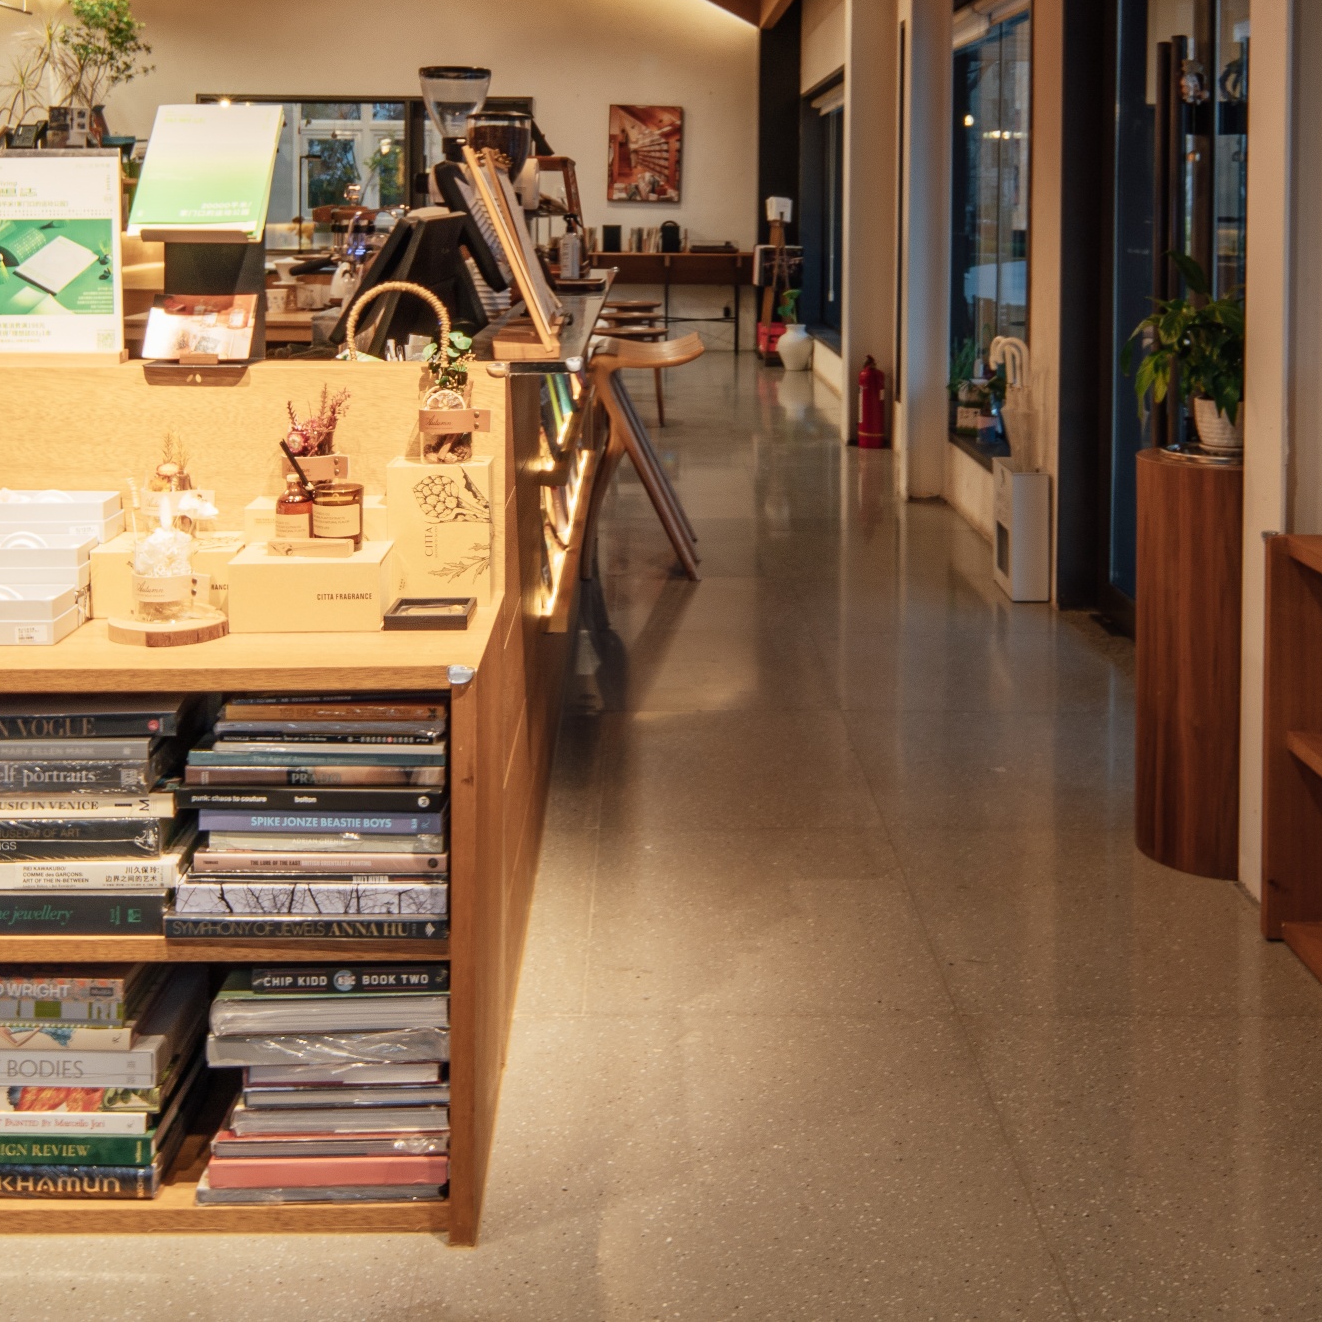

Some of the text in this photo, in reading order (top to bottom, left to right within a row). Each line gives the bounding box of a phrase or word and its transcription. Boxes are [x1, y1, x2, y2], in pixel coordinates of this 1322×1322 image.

[336, 592, 373, 600] FRAGRANCE
[16, 717, 97, 738] VOGUE
[31, 800, 46, 811] IN
[47, 800, 100, 811] VENICE
[211, 795, 267, 804] chaos to couture
[294, 795, 317, 804] bolton
[250, 816, 392, 829] SPIKE JONZE BEASTIE BOYS
[44, 829, 60, 838] OF
[61, 828, 81, 838] ART
[250, 859, 260, 867] THE
[260, 859, 270, 867] LURE
[271, 859, 279, 867] OF
[279, 859, 289, 867] THE
[289, 859, 301, 867] EAST
[105, 875, 158, 883] 边界之间的艺术
[11, 904, 74, 926] jewellery
[172, 921, 411, 937] SYMPHONY OF JEWELS ANNA HU
[263, 973, 429, 987] CHIP KIDD BOOK TWO
[5, 983, 72, 998] WRIGHT
[6, 1058, 85, 1079] BODIES
[54, 1117, 89, 1128] Marcello
[90, 1118, 106, 1130] Jori
[31, 1143, 92, 1158] REVIEW
